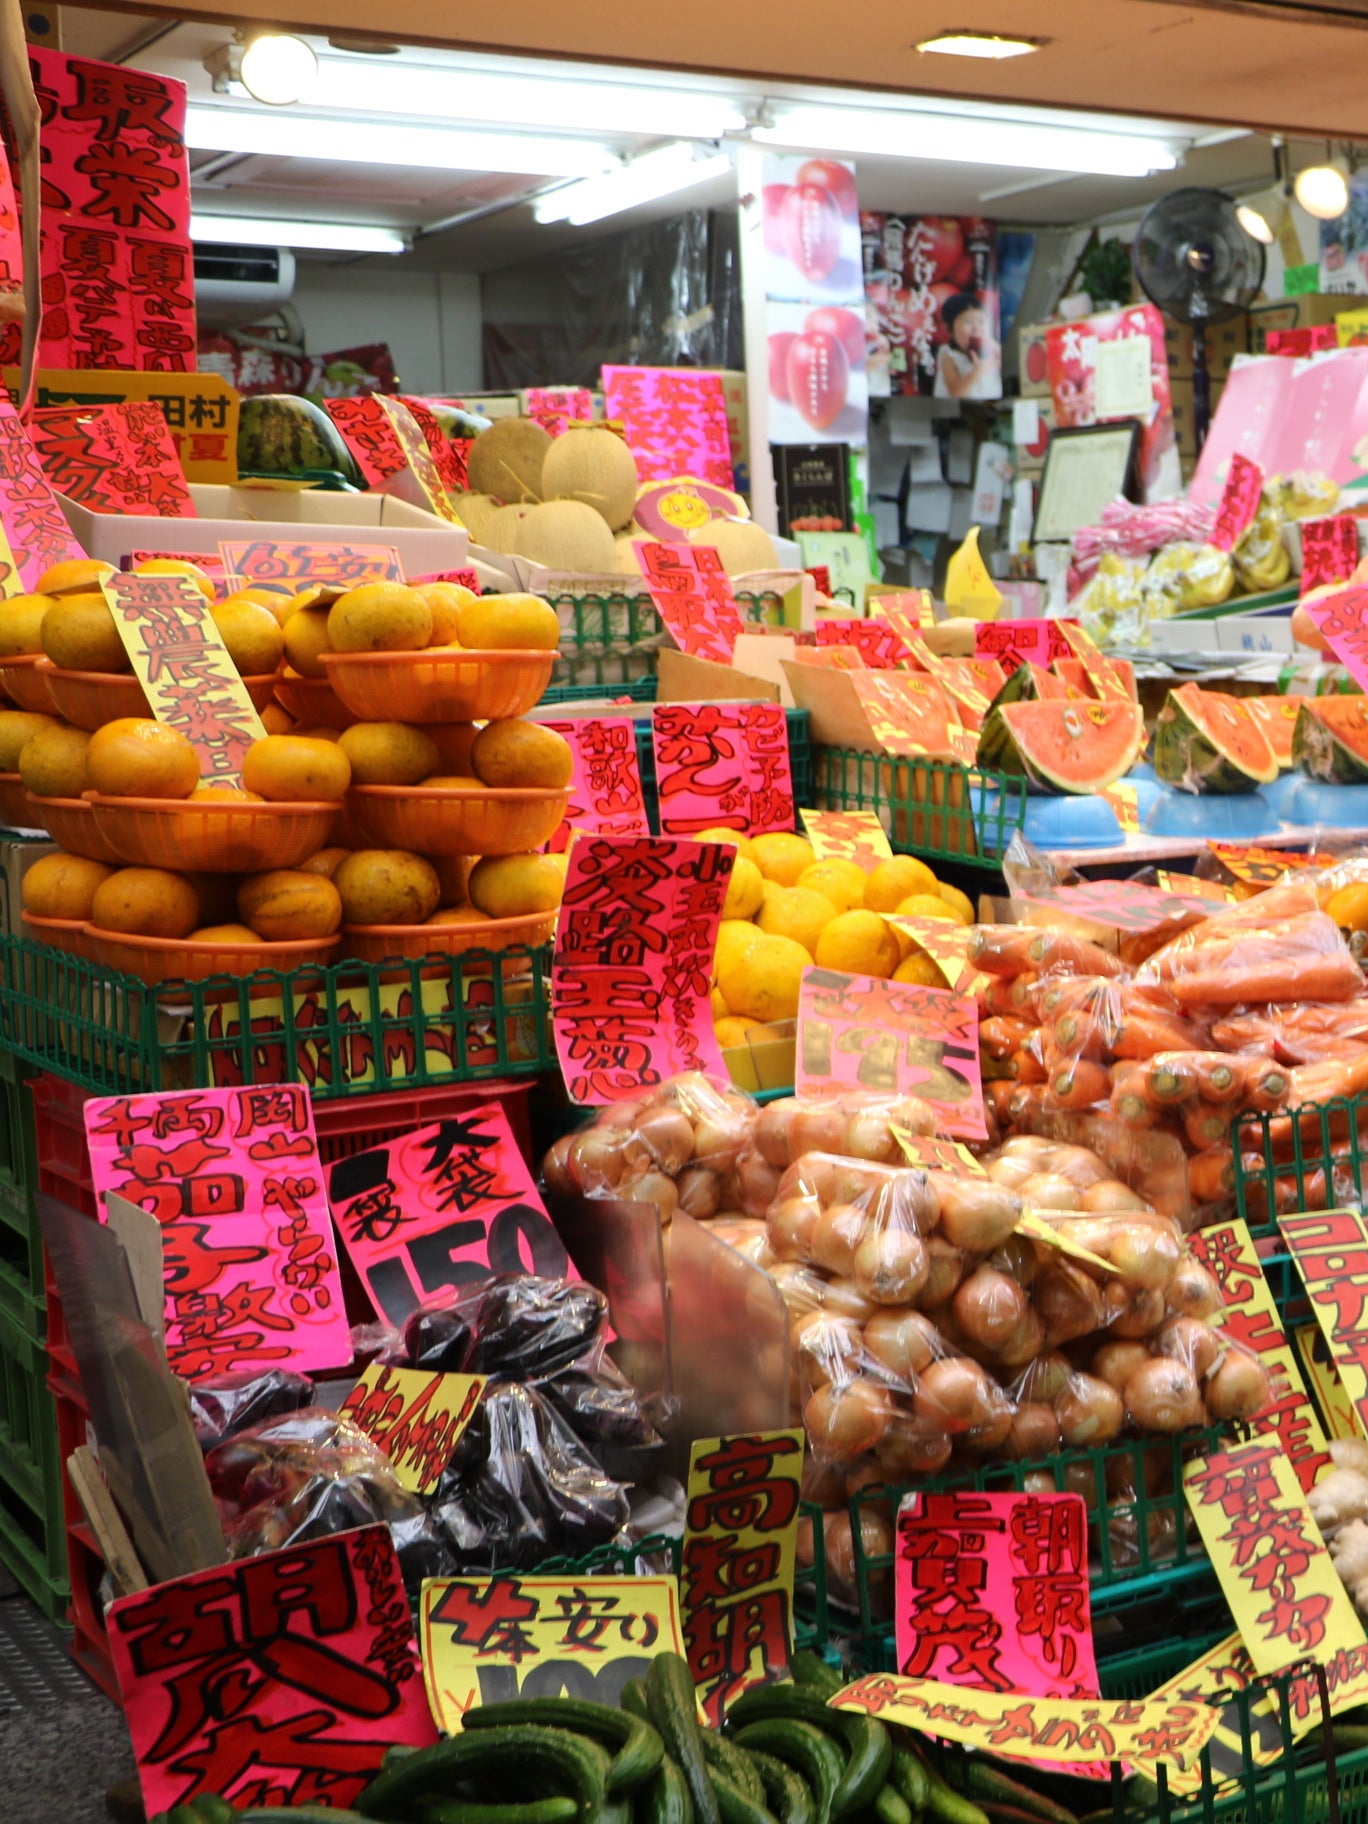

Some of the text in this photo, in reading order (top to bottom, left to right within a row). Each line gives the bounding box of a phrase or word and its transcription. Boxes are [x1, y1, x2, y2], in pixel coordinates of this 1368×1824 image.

[148, 394, 231, 428] 田村
[233, 1089, 316, 1161] 岡山
[422, 1116, 526, 1214] 大袋
[1009, 1496, 1089, 1678] 朝取り
